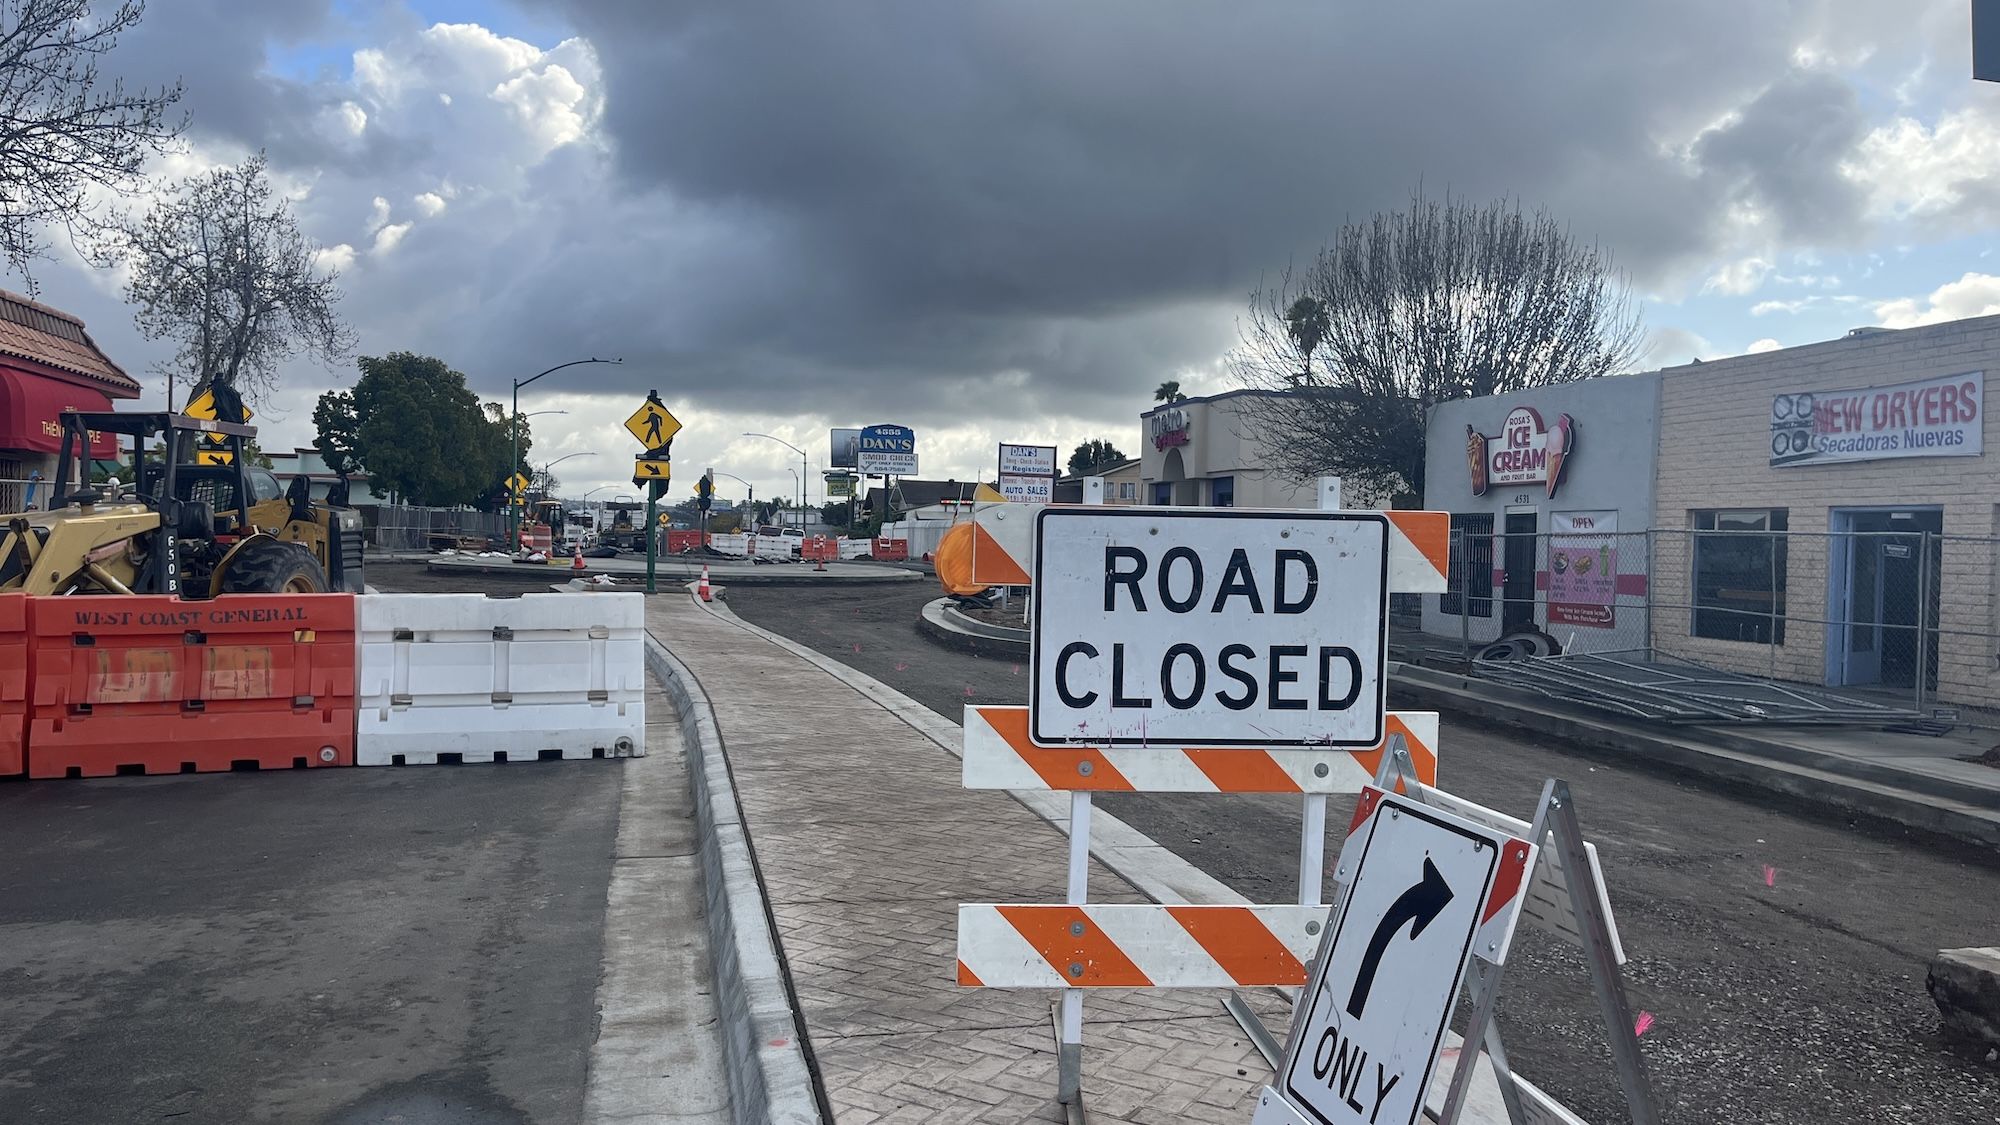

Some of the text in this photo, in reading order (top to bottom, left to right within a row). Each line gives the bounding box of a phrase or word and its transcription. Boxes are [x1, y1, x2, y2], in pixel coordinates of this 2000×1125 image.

[1813, 381, 1977, 434] NEW DRYERS
[1509, 416, 1531, 426] ROSA'S
[863, 437, 912, 451] DAN'S
[1507, 426, 1531, 450] ICE
[1818, 429, 1964, 453] Secadoras Nuevas
[890, 454, 916, 463] CHECK
[1011, 447, 1037, 457] DAN'S
[1492, 447, 1547, 474] CREAM
[1012, 465, 1050, 473] Registration
[1005, 485, 1048, 495] AUTO SALES
[1514, 494, 1530, 504] 4531
[1572, 517, 1595, 529] OPEN
[1104, 546, 1318, 614] ROAD
[75, 607, 307, 626] WEST COAST GENERAL
[1055, 641, 1362, 710] CLOSED
[1313, 1026, 1400, 1125] ONLY
